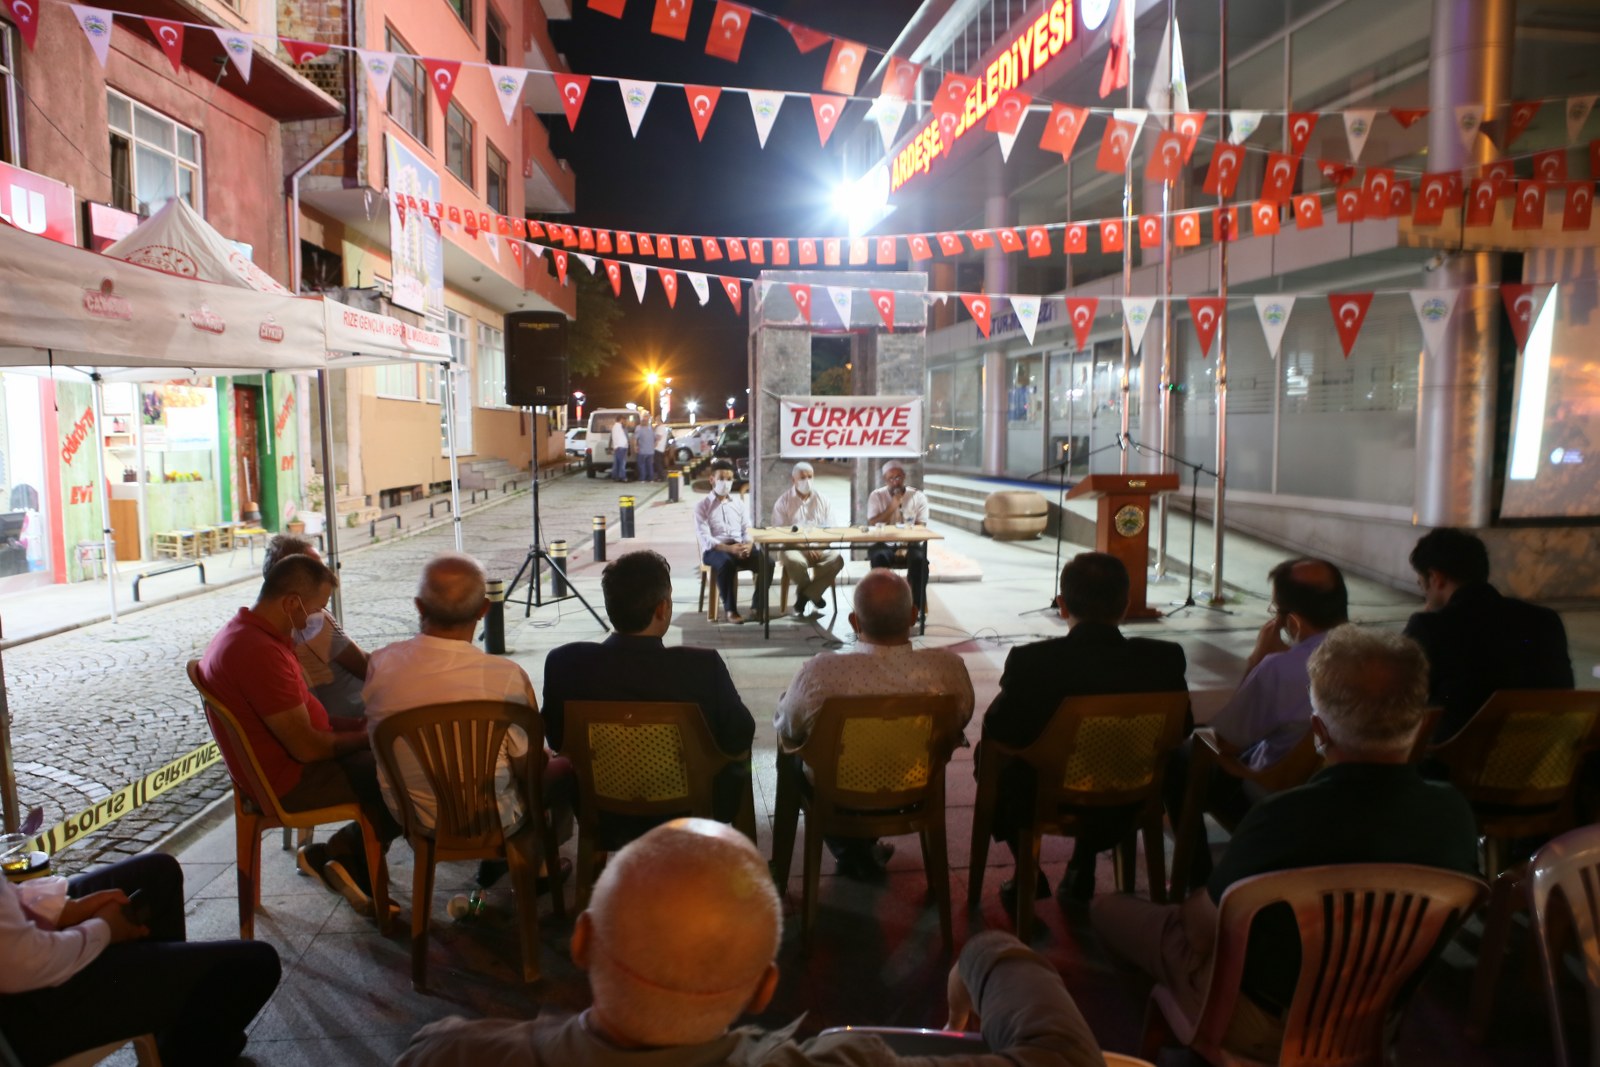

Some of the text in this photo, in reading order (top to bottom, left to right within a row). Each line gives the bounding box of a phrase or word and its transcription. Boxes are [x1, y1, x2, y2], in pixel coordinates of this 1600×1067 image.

[891, 118, 946, 193] ARDEŞE
[790, 402, 911, 427] TÜRKİYE
[790, 429, 911, 450] GEÇİLMEZ
